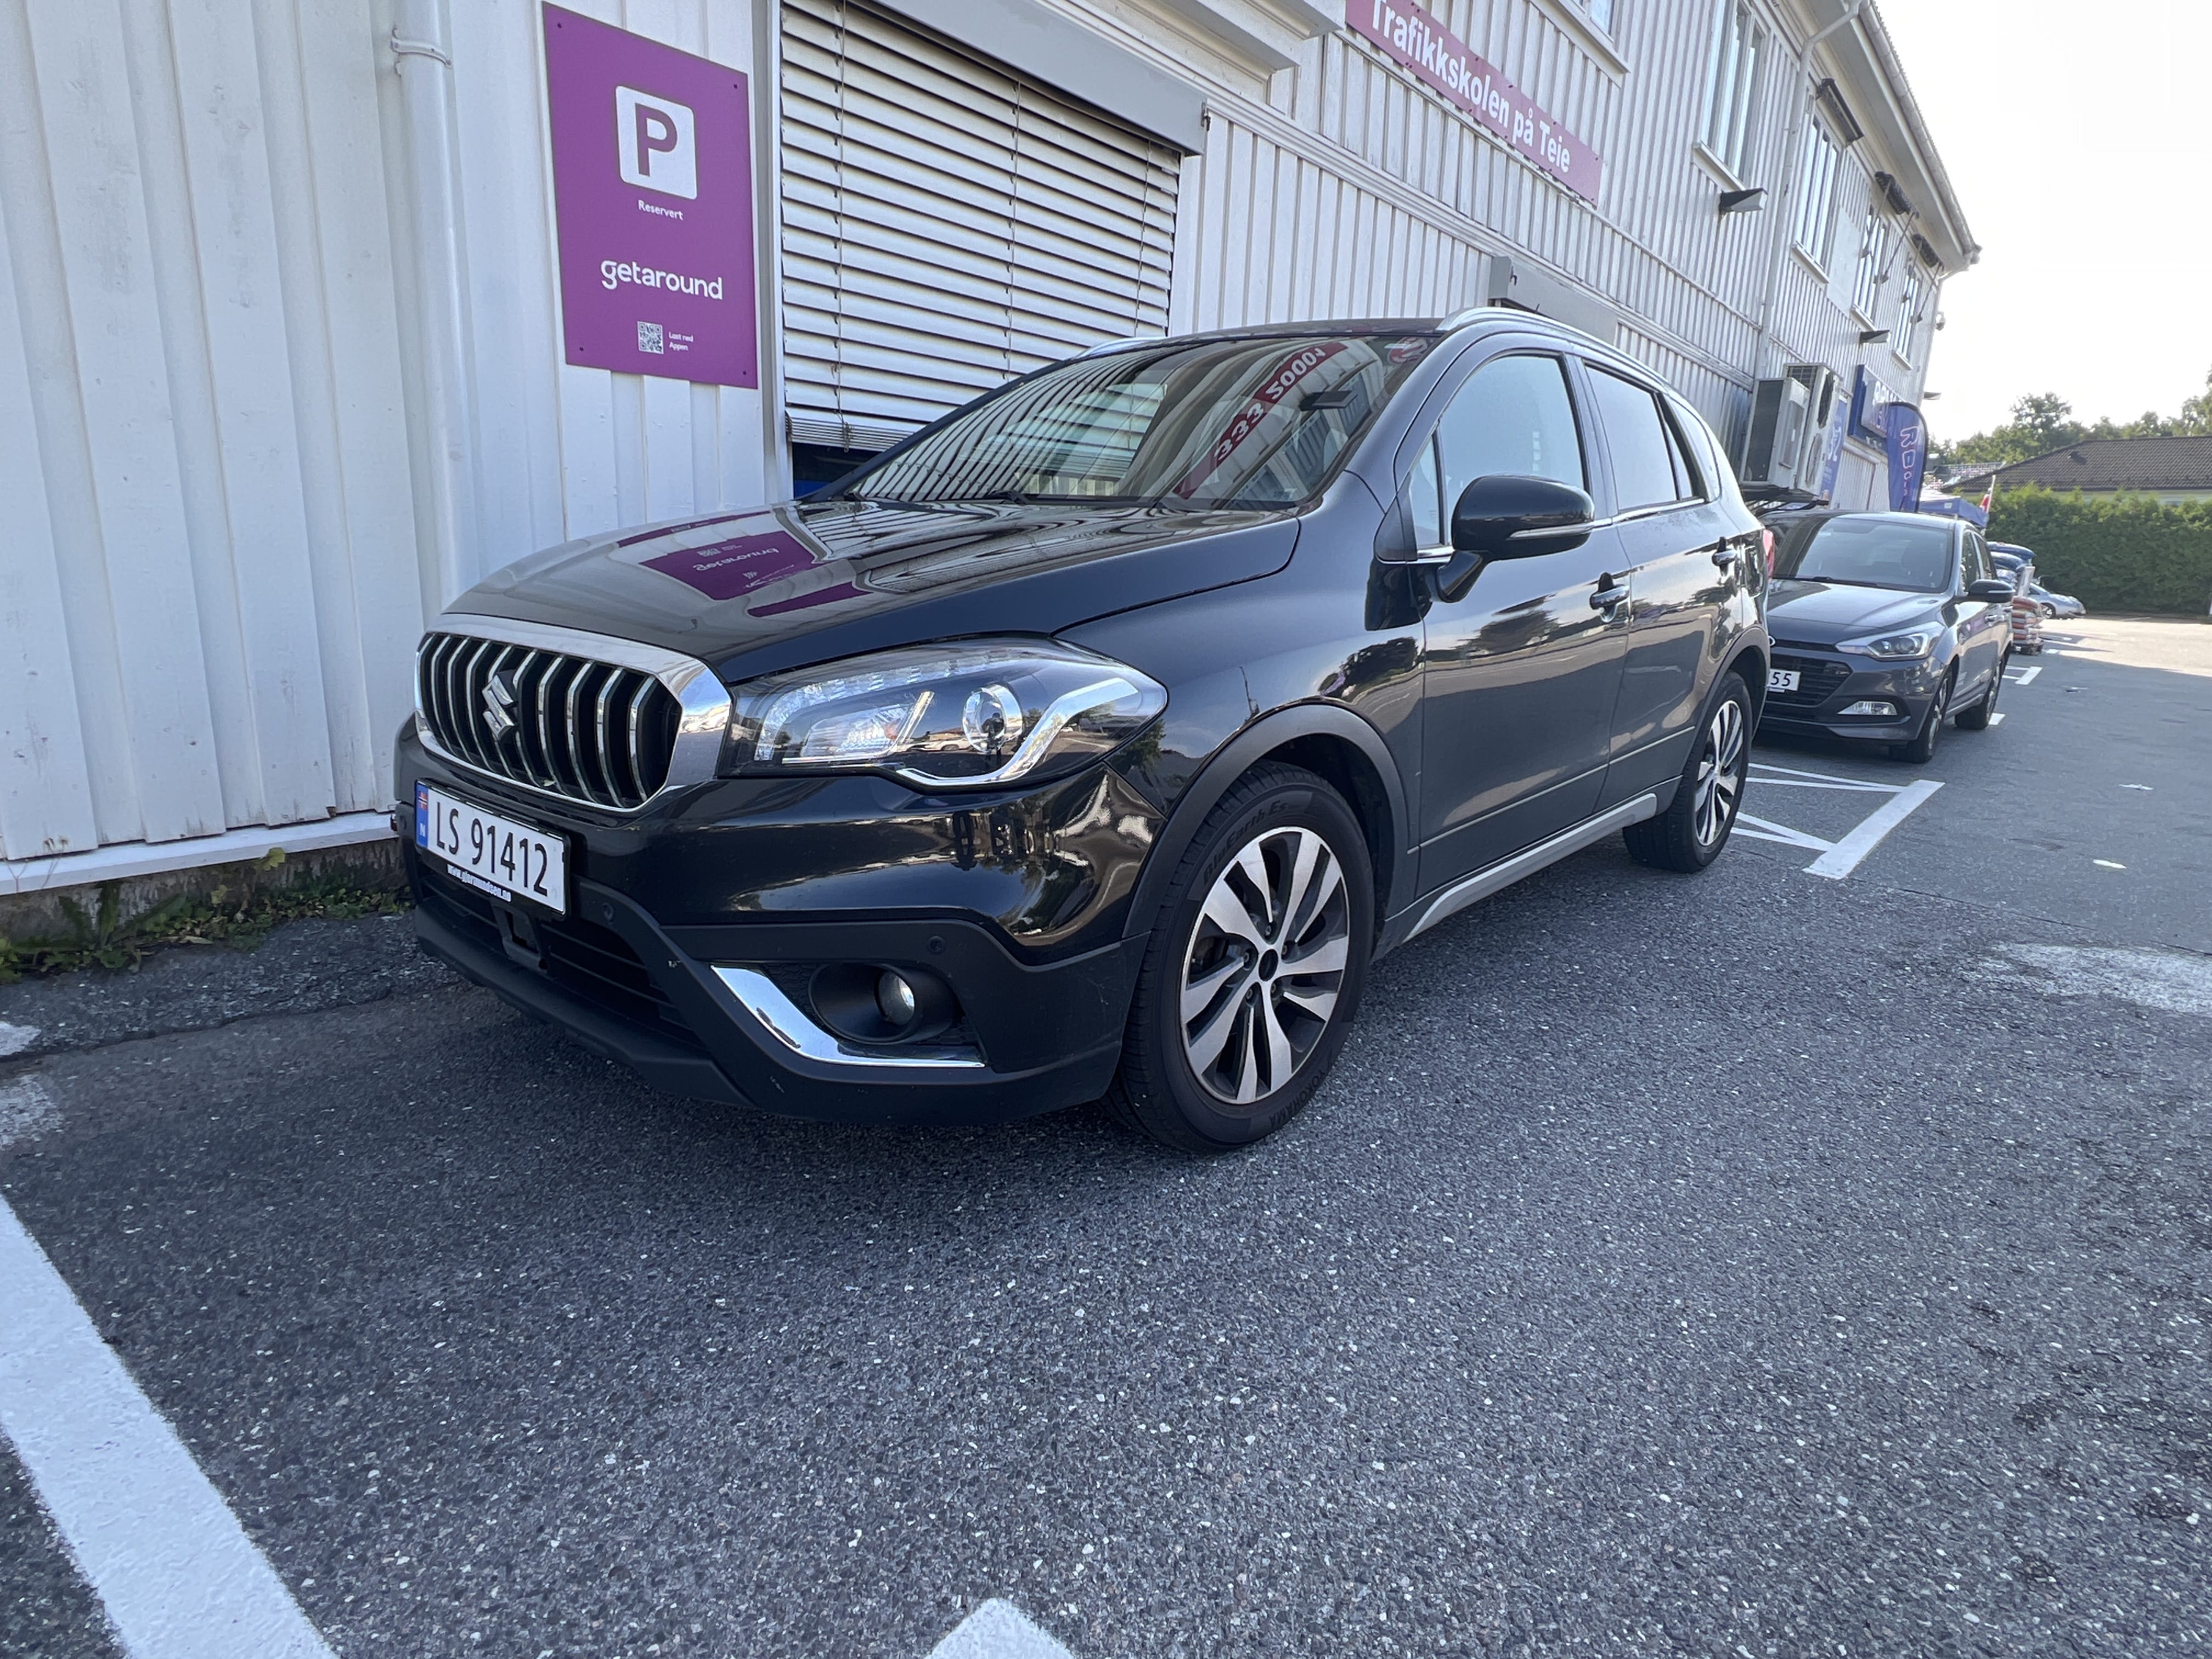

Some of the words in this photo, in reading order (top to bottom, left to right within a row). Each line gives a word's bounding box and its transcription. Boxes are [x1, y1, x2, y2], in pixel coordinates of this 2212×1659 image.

[1373, 0, 1509, 128] Trafikkskolen
[1513, 108, 1533, 146] på
[1540, 120, 1570, 172] Teie
[634, 103, 677, 177] P
[638, 200, 684, 221] Reservert
[601, 261, 723, 300] getaround
[437, 802, 459, 854] LS
[471, 818, 548, 896] 91412
